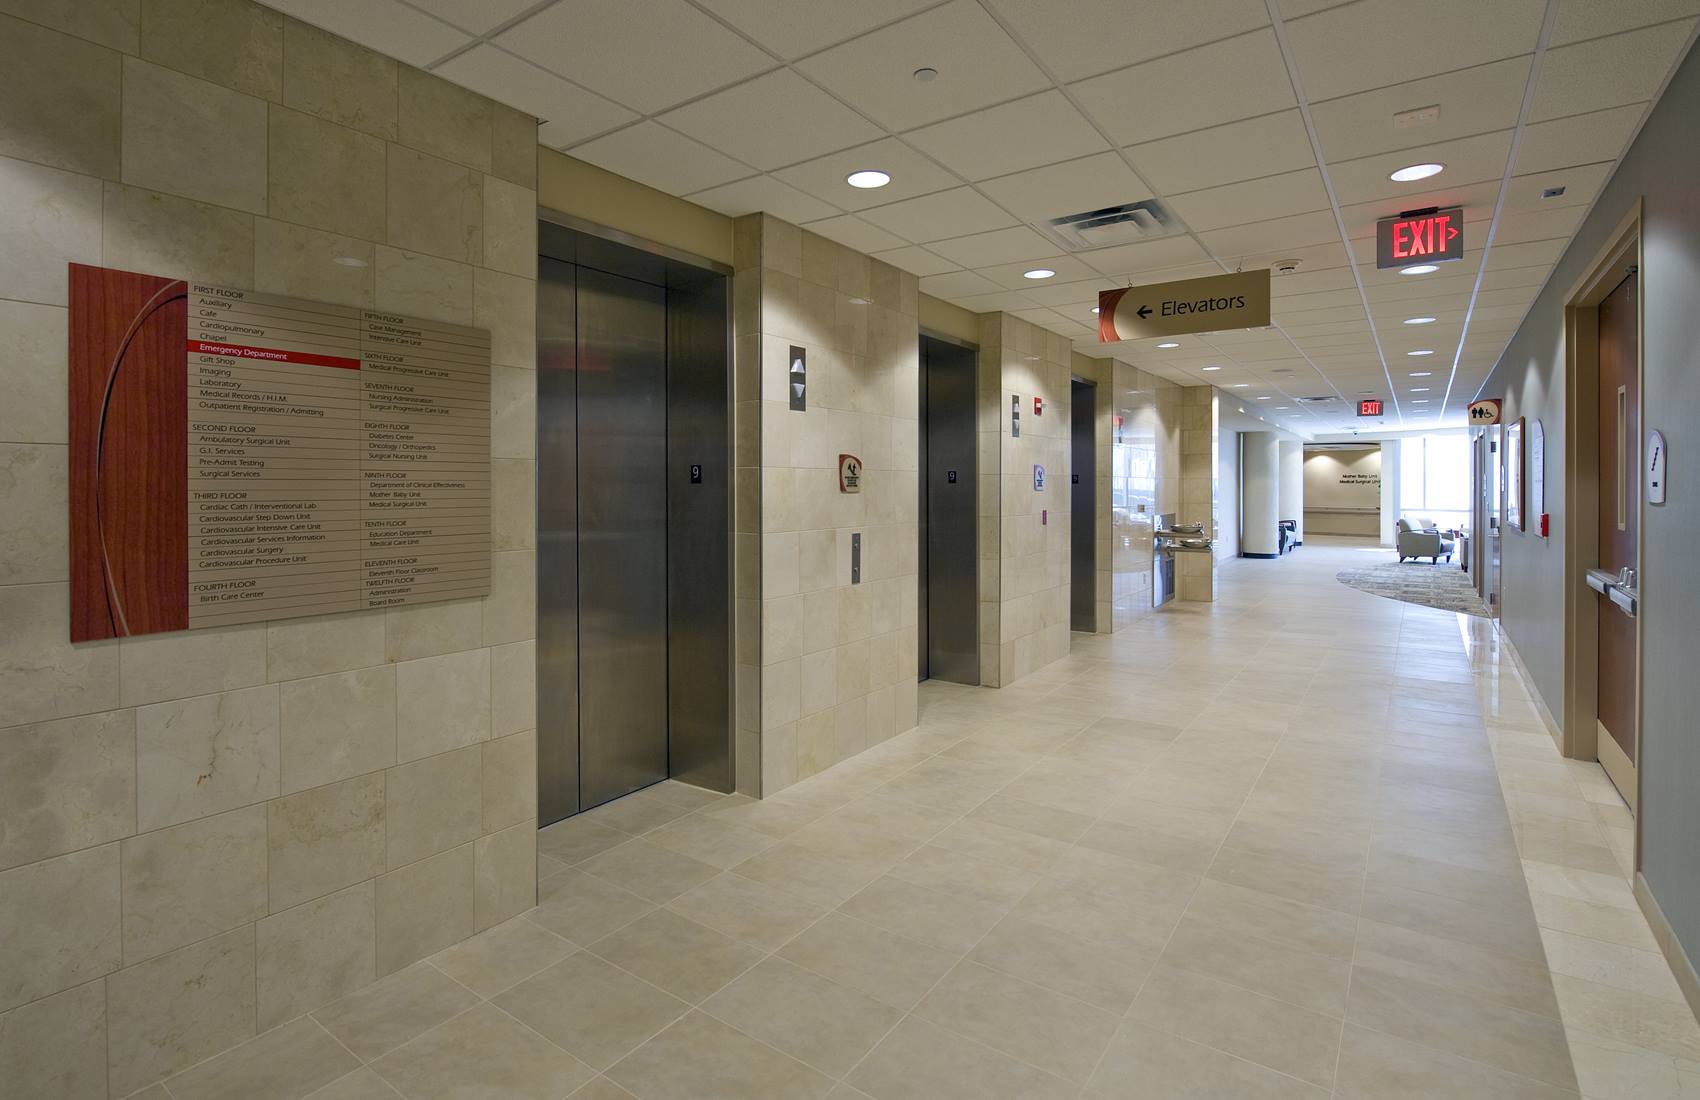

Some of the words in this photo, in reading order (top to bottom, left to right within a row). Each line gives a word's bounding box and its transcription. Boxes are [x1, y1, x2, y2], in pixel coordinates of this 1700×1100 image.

[1393, 215, 1450, 259] EXIT
[194, 286, 213, 294] FIRST
[216, 288, 244, 299] FLOOR
[200, 299, 232, 309] Auxiliary
[1161, 295, 1245, 316] Elevators
[200, 321, 264, 336] Cardiopulmonary
[200, 333, 226, 342] Chapel
[200, 344, 242, 356] Emergency
[244, 349, 287, 360] Department
[200, 356, 214, 364] Gift
[216, 357, 235, 366] Shop
[200, 368, 231, 377] Imaging
[200, 379, 241, 389] Laboratory
[200, 390, 229, 398] Medical
[232, 392, 260, 400] Records
[200, 402, 240, 411] Outpatient
[243, 405, 284, 415] Registration
[291, 408, 324, 416] Admitting
[1362, 402, 1380, 414] EXIT
[192, 424, 227, 432] SECOND
[200, 436, 244, 445] Ambulatory
[247, 437, 273, 446] Surgical
[239, 460, 264, 468] Testing
[200, 470, 229, 478] Surgical
[693, 466, 698, 478] 9
[256, 514, 271, 522] Step
[201, 526, 254, 534] Cardiovascular
[257, 524, 287, 532] Intensive
[201, 537, 255, 546] Cardiovascular
[257, 536, 284, 544] Services
[287, 534, 325, 542] Information
[200, 549, 254, 557] Cardiovascular
[256, 546, 283, 554] Surgery
[200, 559, 253, 568] Cardiovascular
[201, 594, 218, 602] Birth
[240, 591, 264, 599] Center
